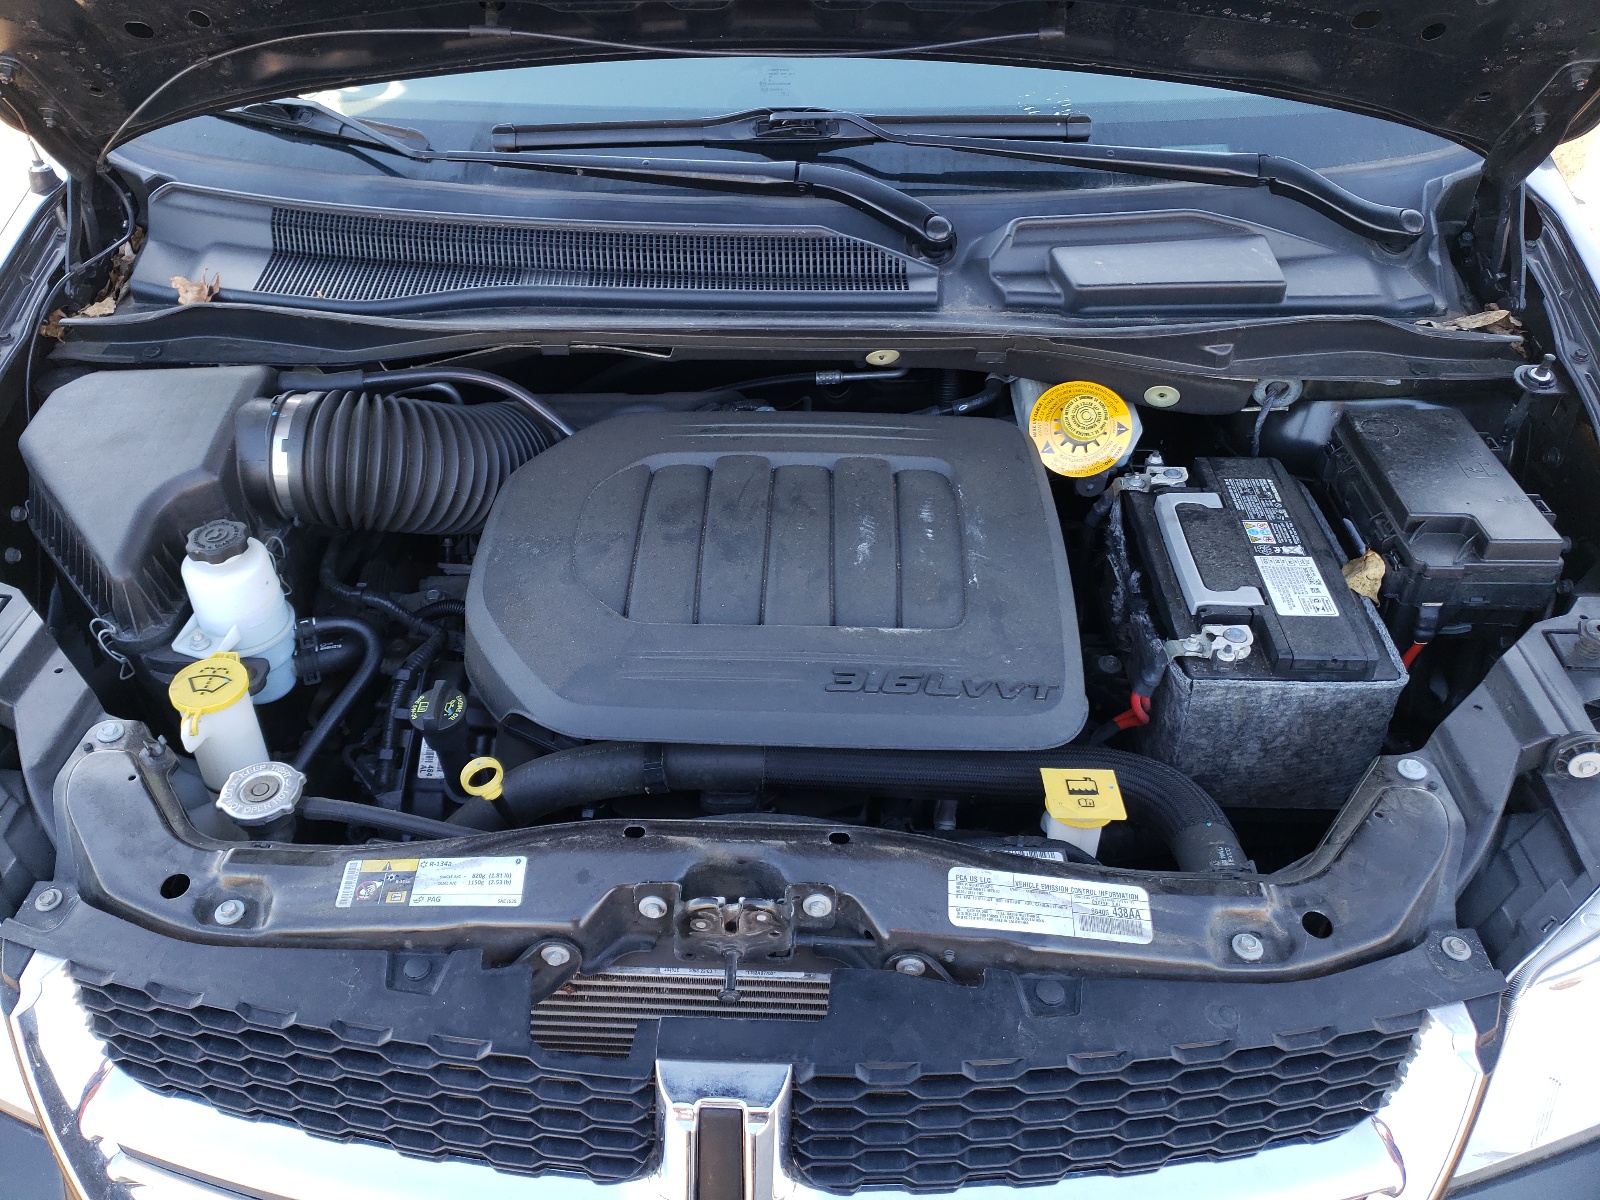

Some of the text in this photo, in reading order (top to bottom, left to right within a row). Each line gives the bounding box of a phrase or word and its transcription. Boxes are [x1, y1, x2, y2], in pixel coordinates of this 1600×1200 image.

[962, 680, 1060, 701] VVT
[239, 764, 267, 778] KEEP
[243, 802, 271, 813] OPEN
[1015, 881, 1040, 889] VEHICLE
[1041, 883, 1069, 893] EMISSION
[1070, 886, 1098, 896] CONTROL
[1099, 890, 1139, 900] INFORMATION
[1112, 907, 1141, 920] 438AA
